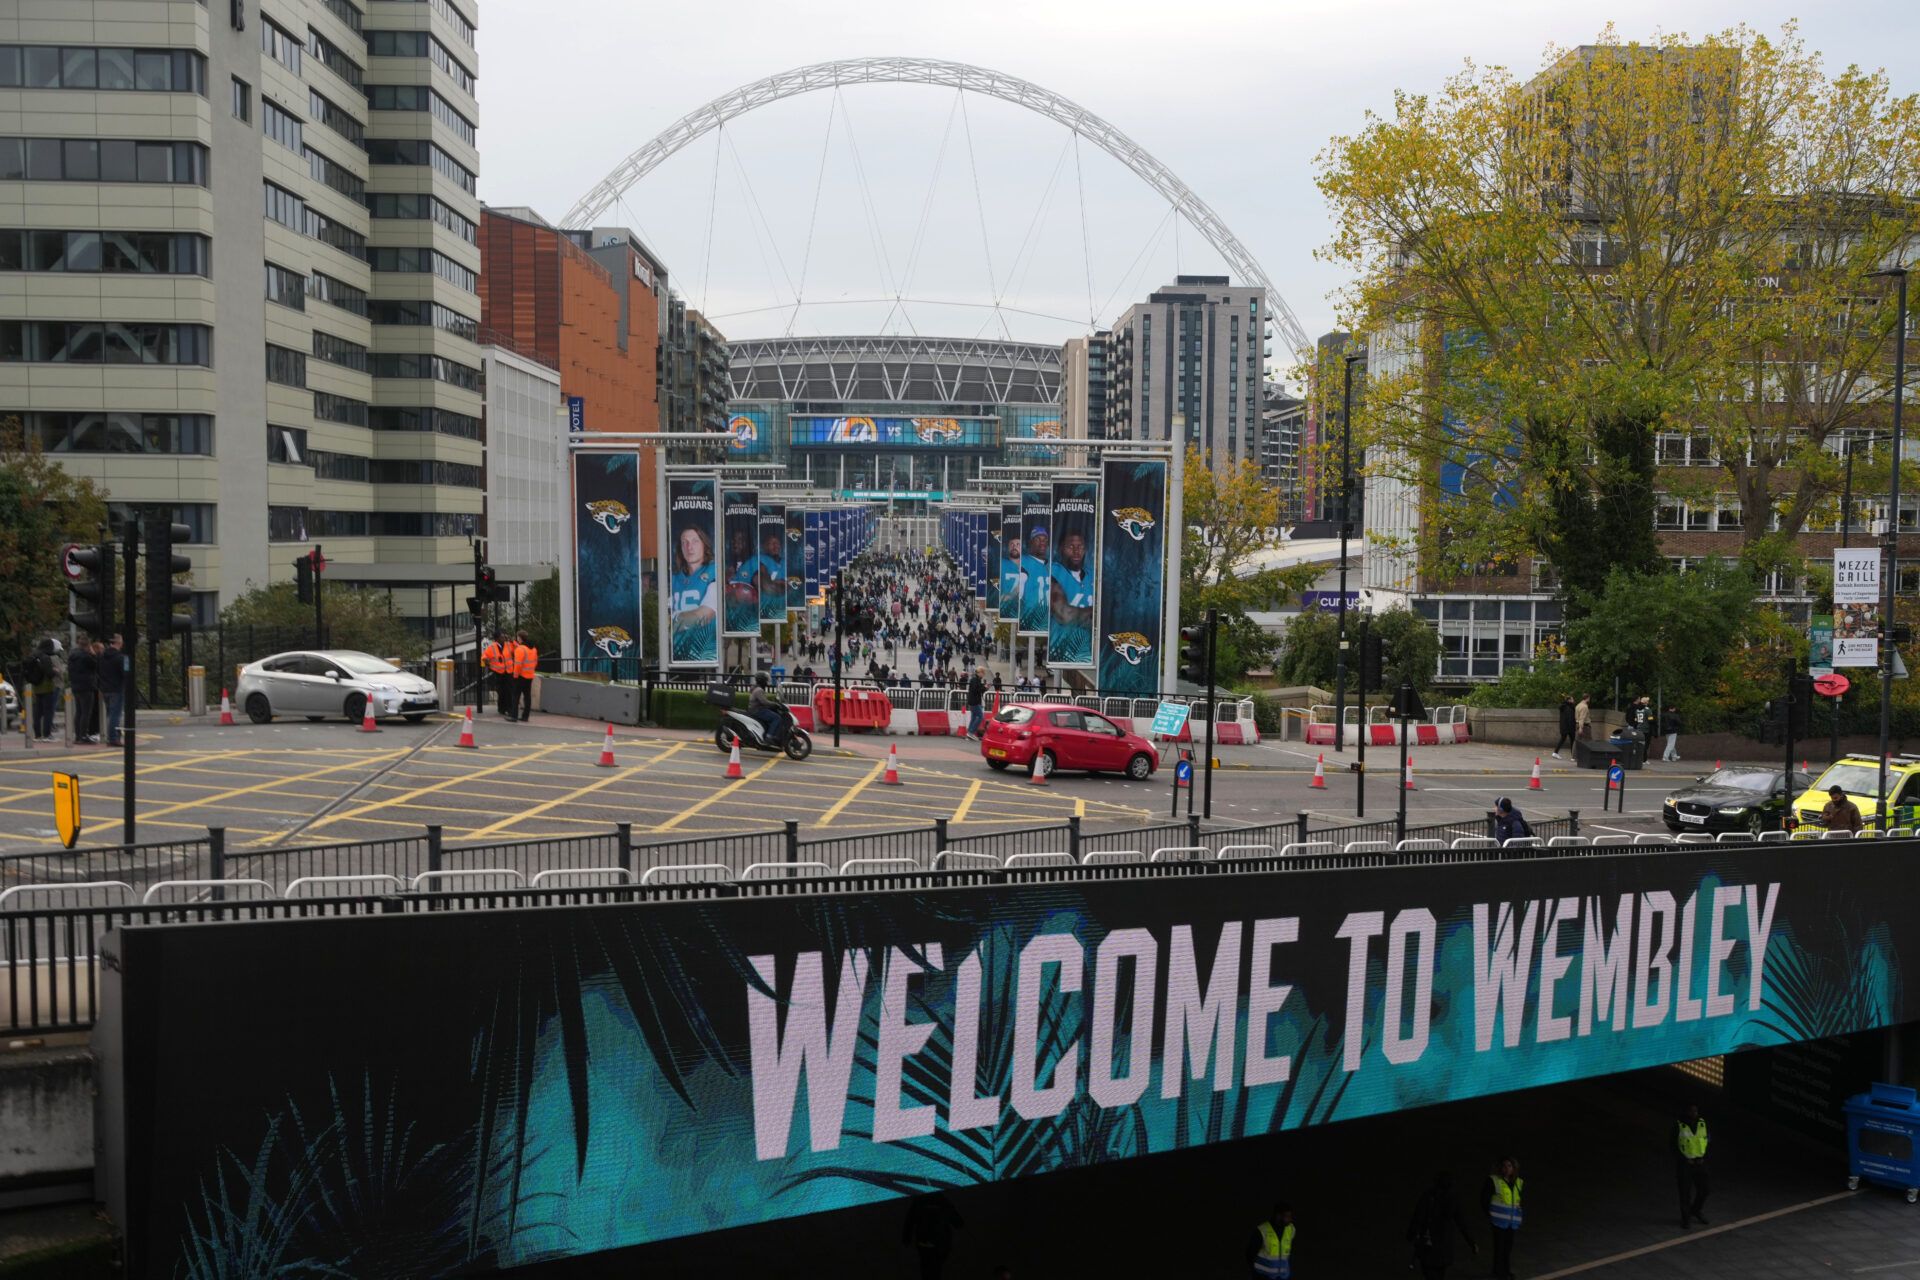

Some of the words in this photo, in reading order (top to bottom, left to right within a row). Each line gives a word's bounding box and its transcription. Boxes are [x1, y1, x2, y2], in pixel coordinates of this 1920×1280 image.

[672, 500, 713, 511] JAGUARS
[1054, 503, 1095, 514] JAGUARS
[725, 507, 757, 516] JAGUARS
[759, 517, 785, 525] JAGUARS
[1838, 560, 1875, 571] MEZZE
[1838, 571, 1875, 582] GRILL
[1320, 597, 1360, 610] curys
[1636, 713, 1644, 724] 12
[747, 916, 1300, 1161] WELCOME
[1335, 908, 1437, 1072] TO
[1470, 882, 1782, 1053] WEMBLEY
